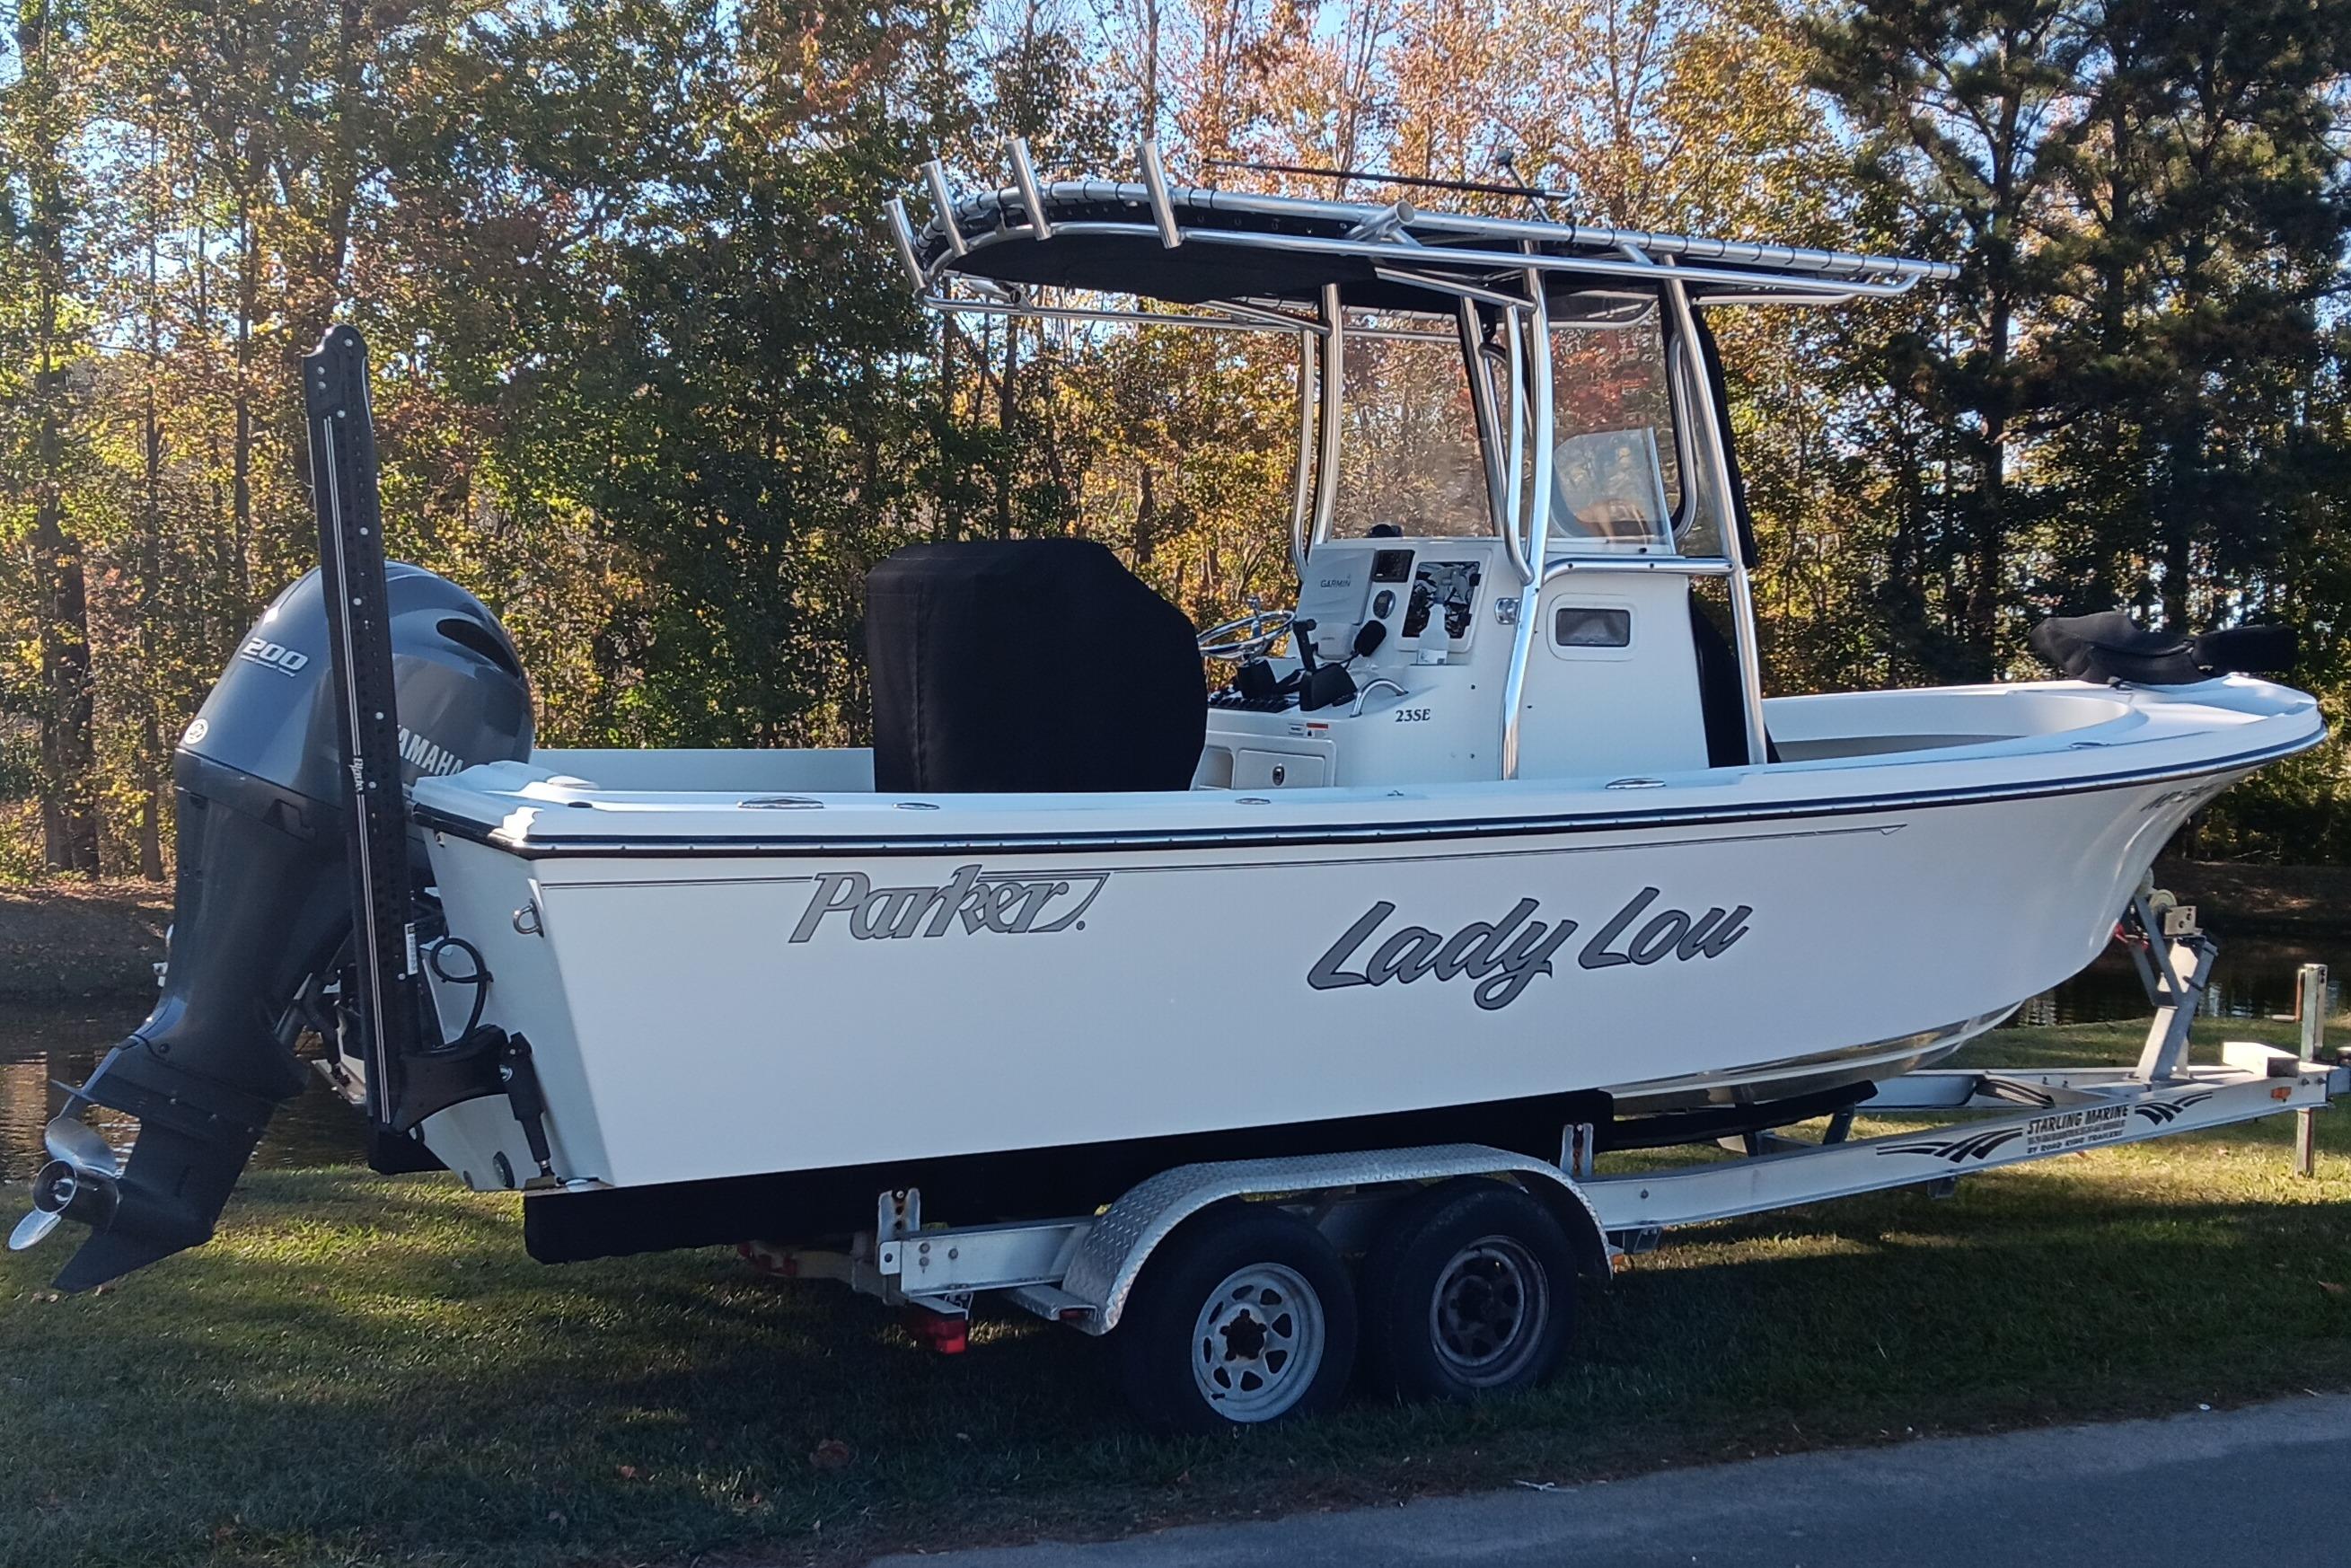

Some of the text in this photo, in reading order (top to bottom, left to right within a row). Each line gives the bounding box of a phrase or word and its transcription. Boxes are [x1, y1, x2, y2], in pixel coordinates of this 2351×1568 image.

[1320, 578, 1352, 588] GARMIN
[242, 637, 309, 673] 200
[1396, 708, 1431, 723] 23SE
[397, 724, 464, 776] AMAHA
[1308, 886, 1753, 1010] Lady Lou
[2027, 1112, 2082, 1134] STARLING
[2085, 1105, 2128, 1123] MARINE
